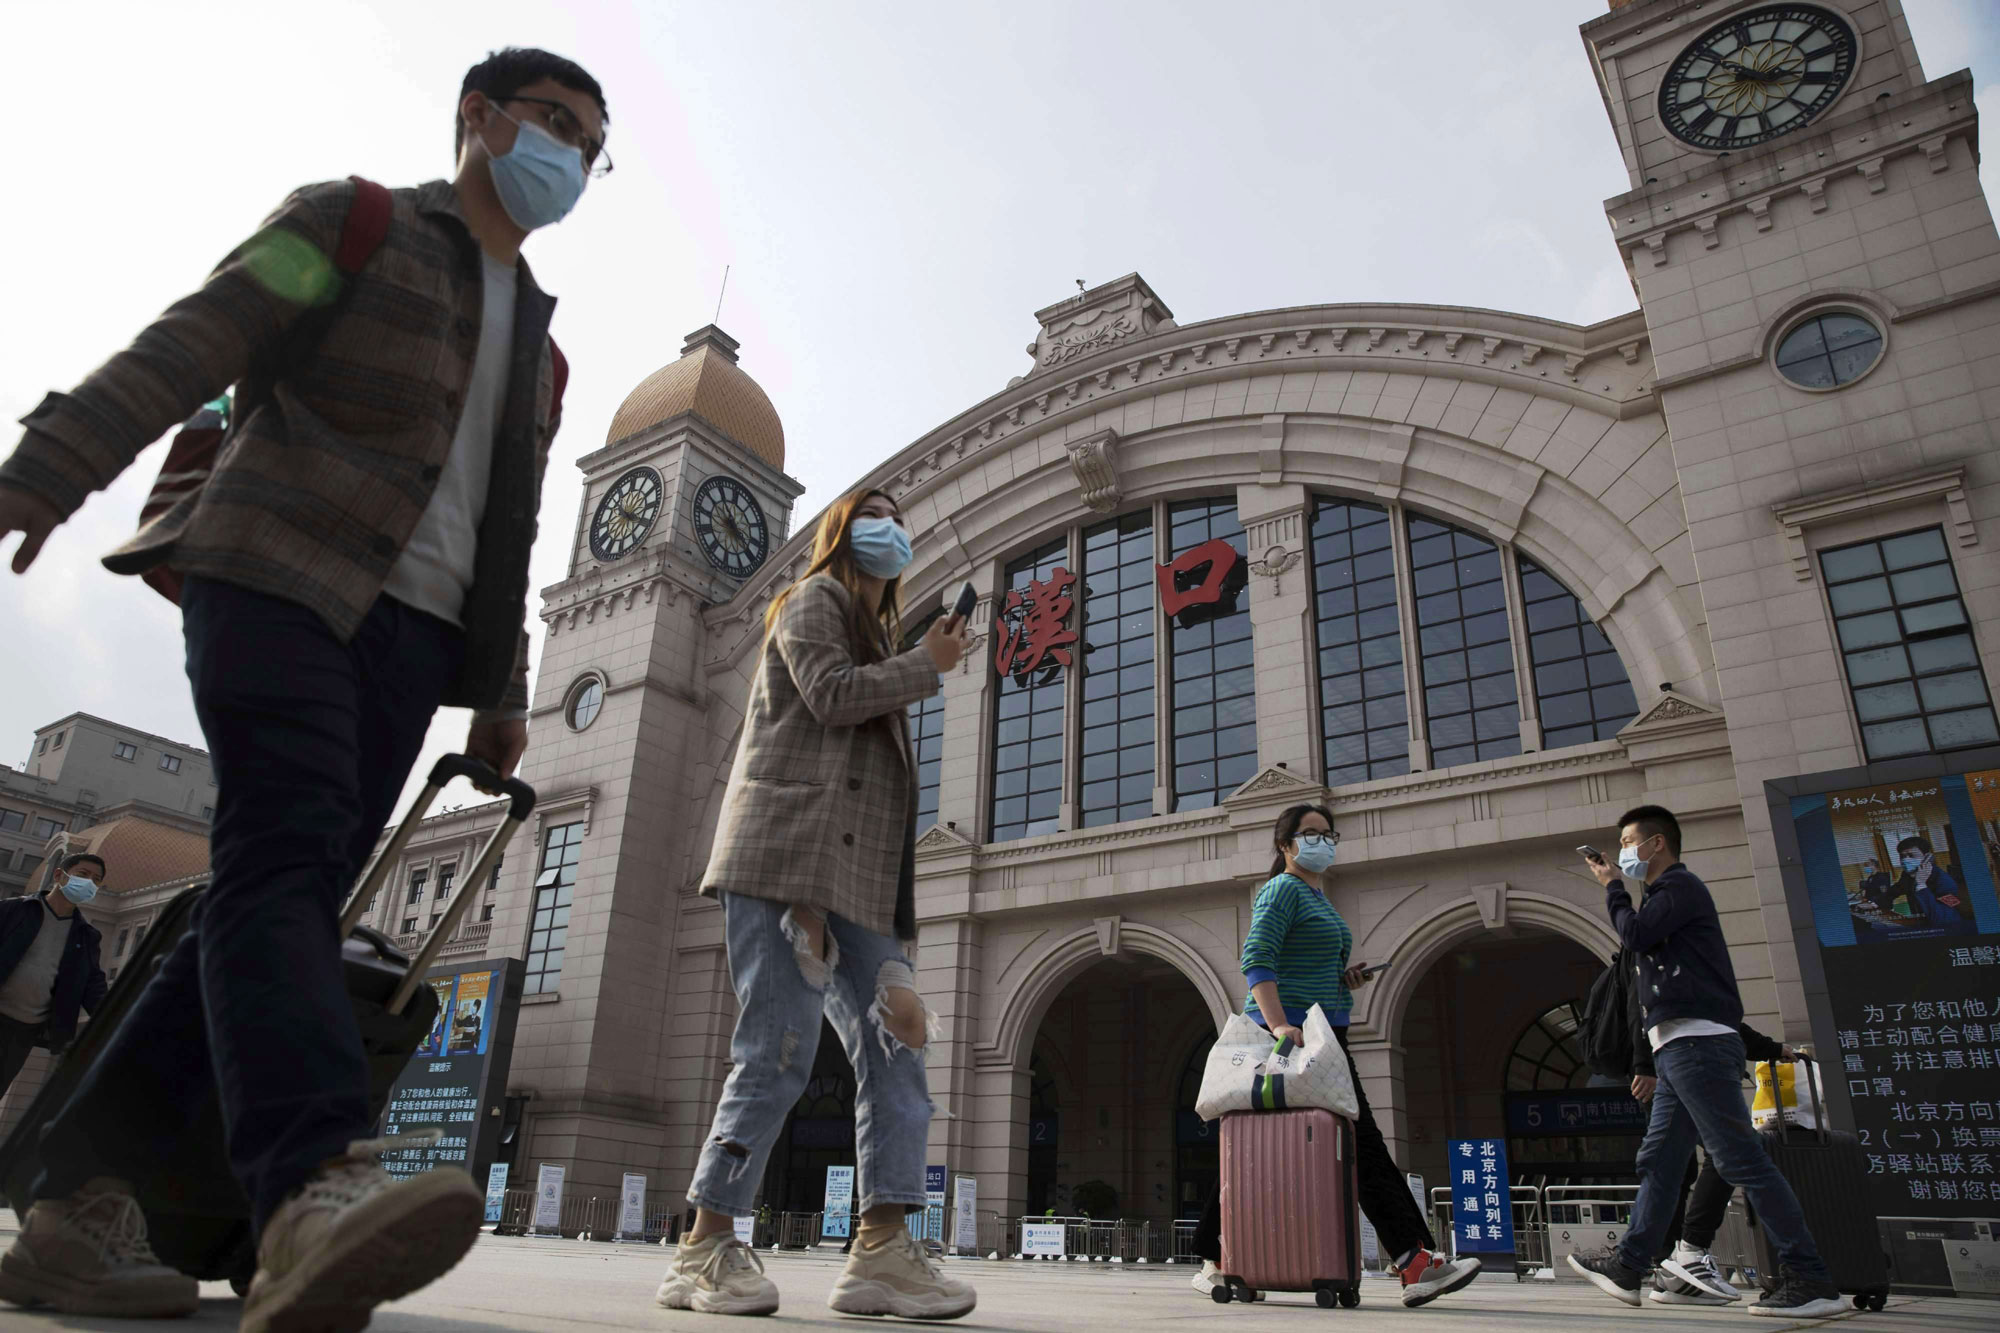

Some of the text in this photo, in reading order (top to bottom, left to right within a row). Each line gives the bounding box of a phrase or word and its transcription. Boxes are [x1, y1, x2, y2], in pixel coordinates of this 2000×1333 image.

[995, 539, 1237, 677] 漢口
[1949, 945, 2000, 967] 温馨
[1843, 1047, 2000, 1073] 量，并注意排
[1527, 1104, 1542, 1127] 5
[1586, 1102, 1643, 1117] 南1进站
[1891, 1100, 2000, 1122] 北京方向
[1035, 1122, 1046, 1141] 2
[1866, 1153, 2000, 1174] 务驿站联系
[926, 1172, 941, 1180] 站口
[1458, 1142, 1482, 1240] 专用通道
[1480, 1142, 1503, 1240] 北京方向列车
